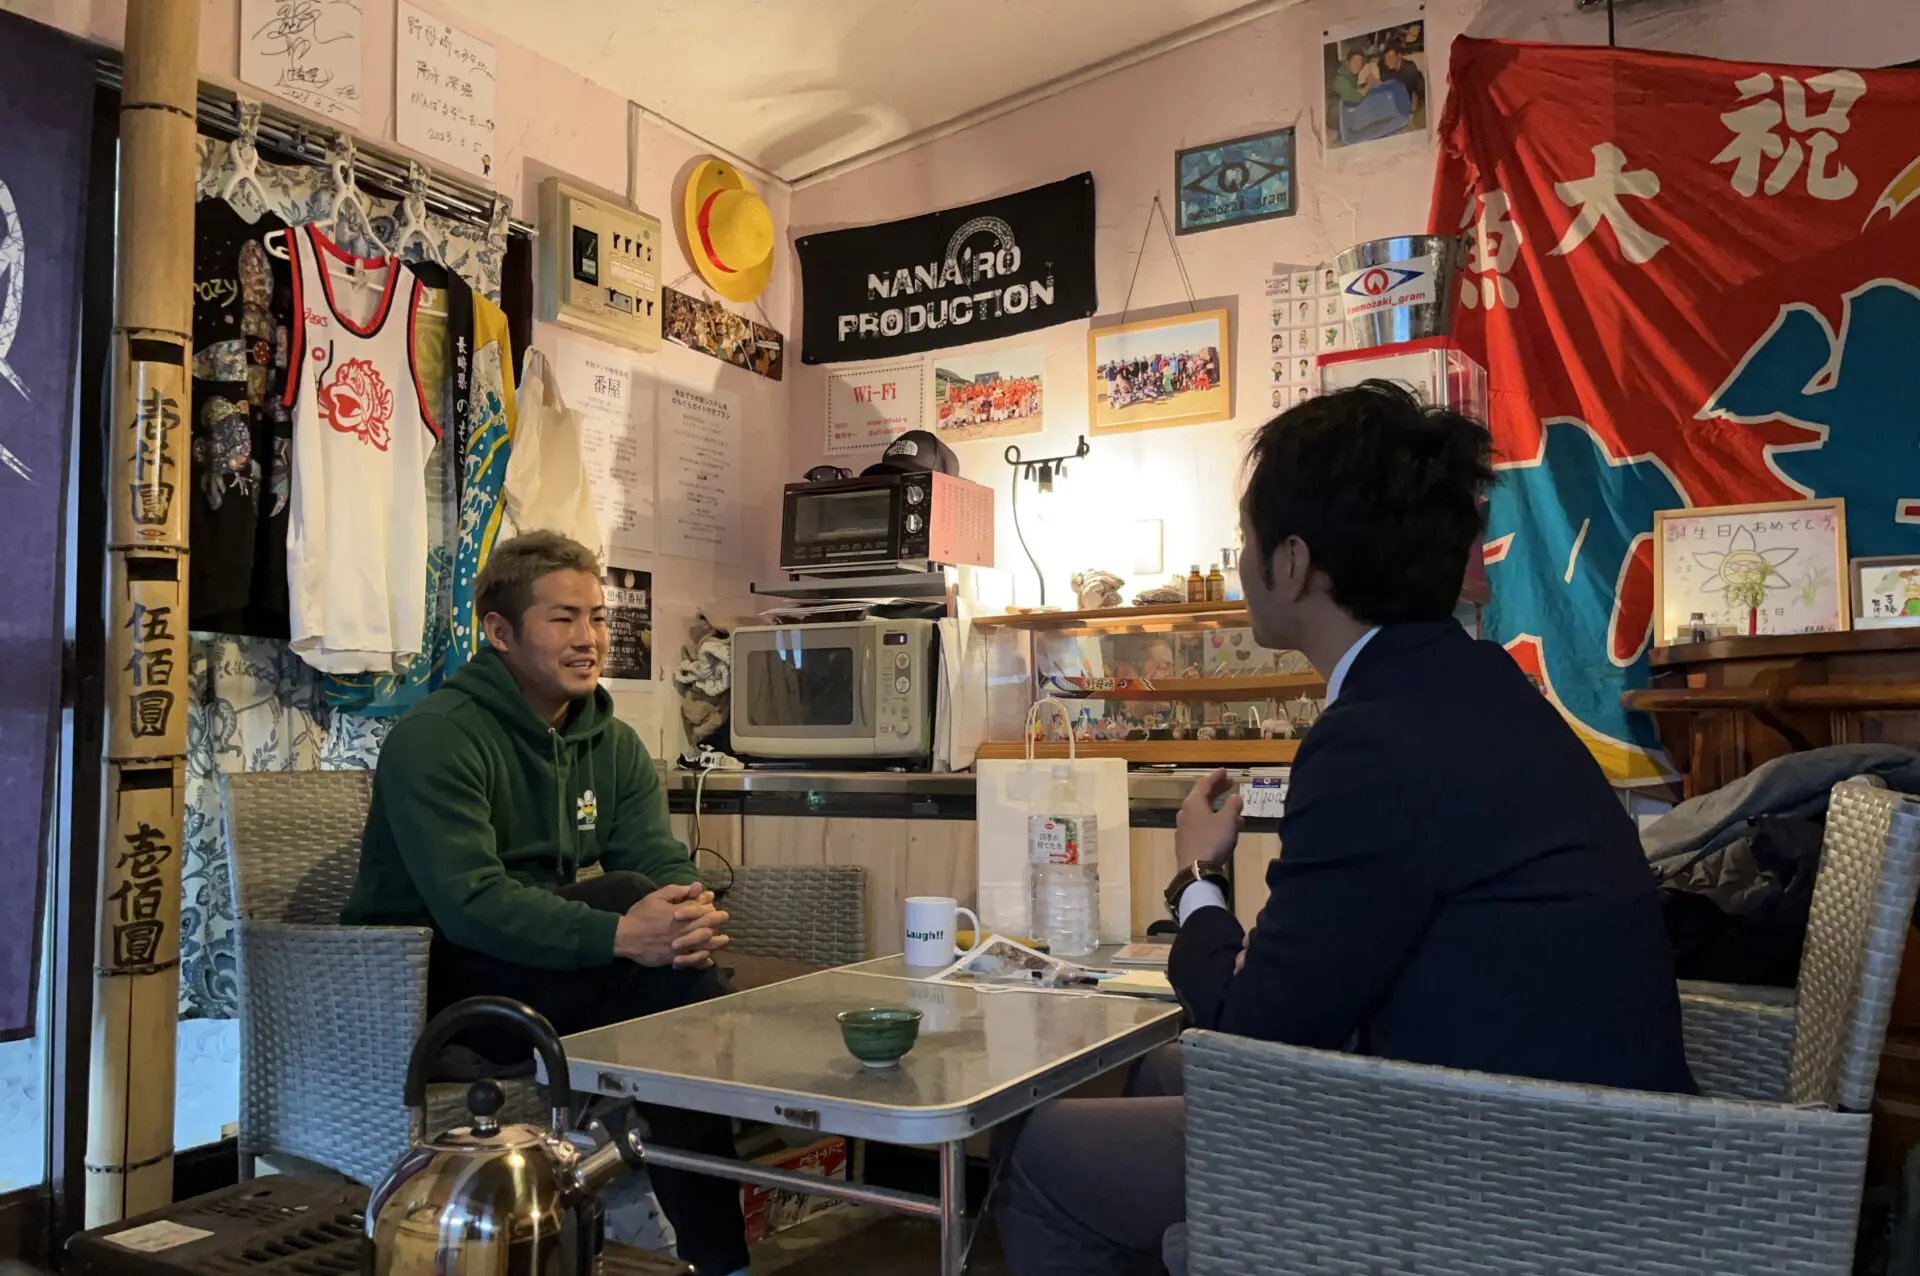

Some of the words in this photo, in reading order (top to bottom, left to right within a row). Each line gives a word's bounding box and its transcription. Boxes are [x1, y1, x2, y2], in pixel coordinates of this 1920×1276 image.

[1711, 69, 1868, 197] 祝
[867, 245, 1022, 301] NANAIRO
[838, 273, 1055, 342] PRODUCTION
[594, 375, 621, 399] 番屋
[853, 382, 897, 404] Wi-Fi
[122, 602, 176, 739] 伍佰圓
[906, 928, 944, 942] Laugh!!
